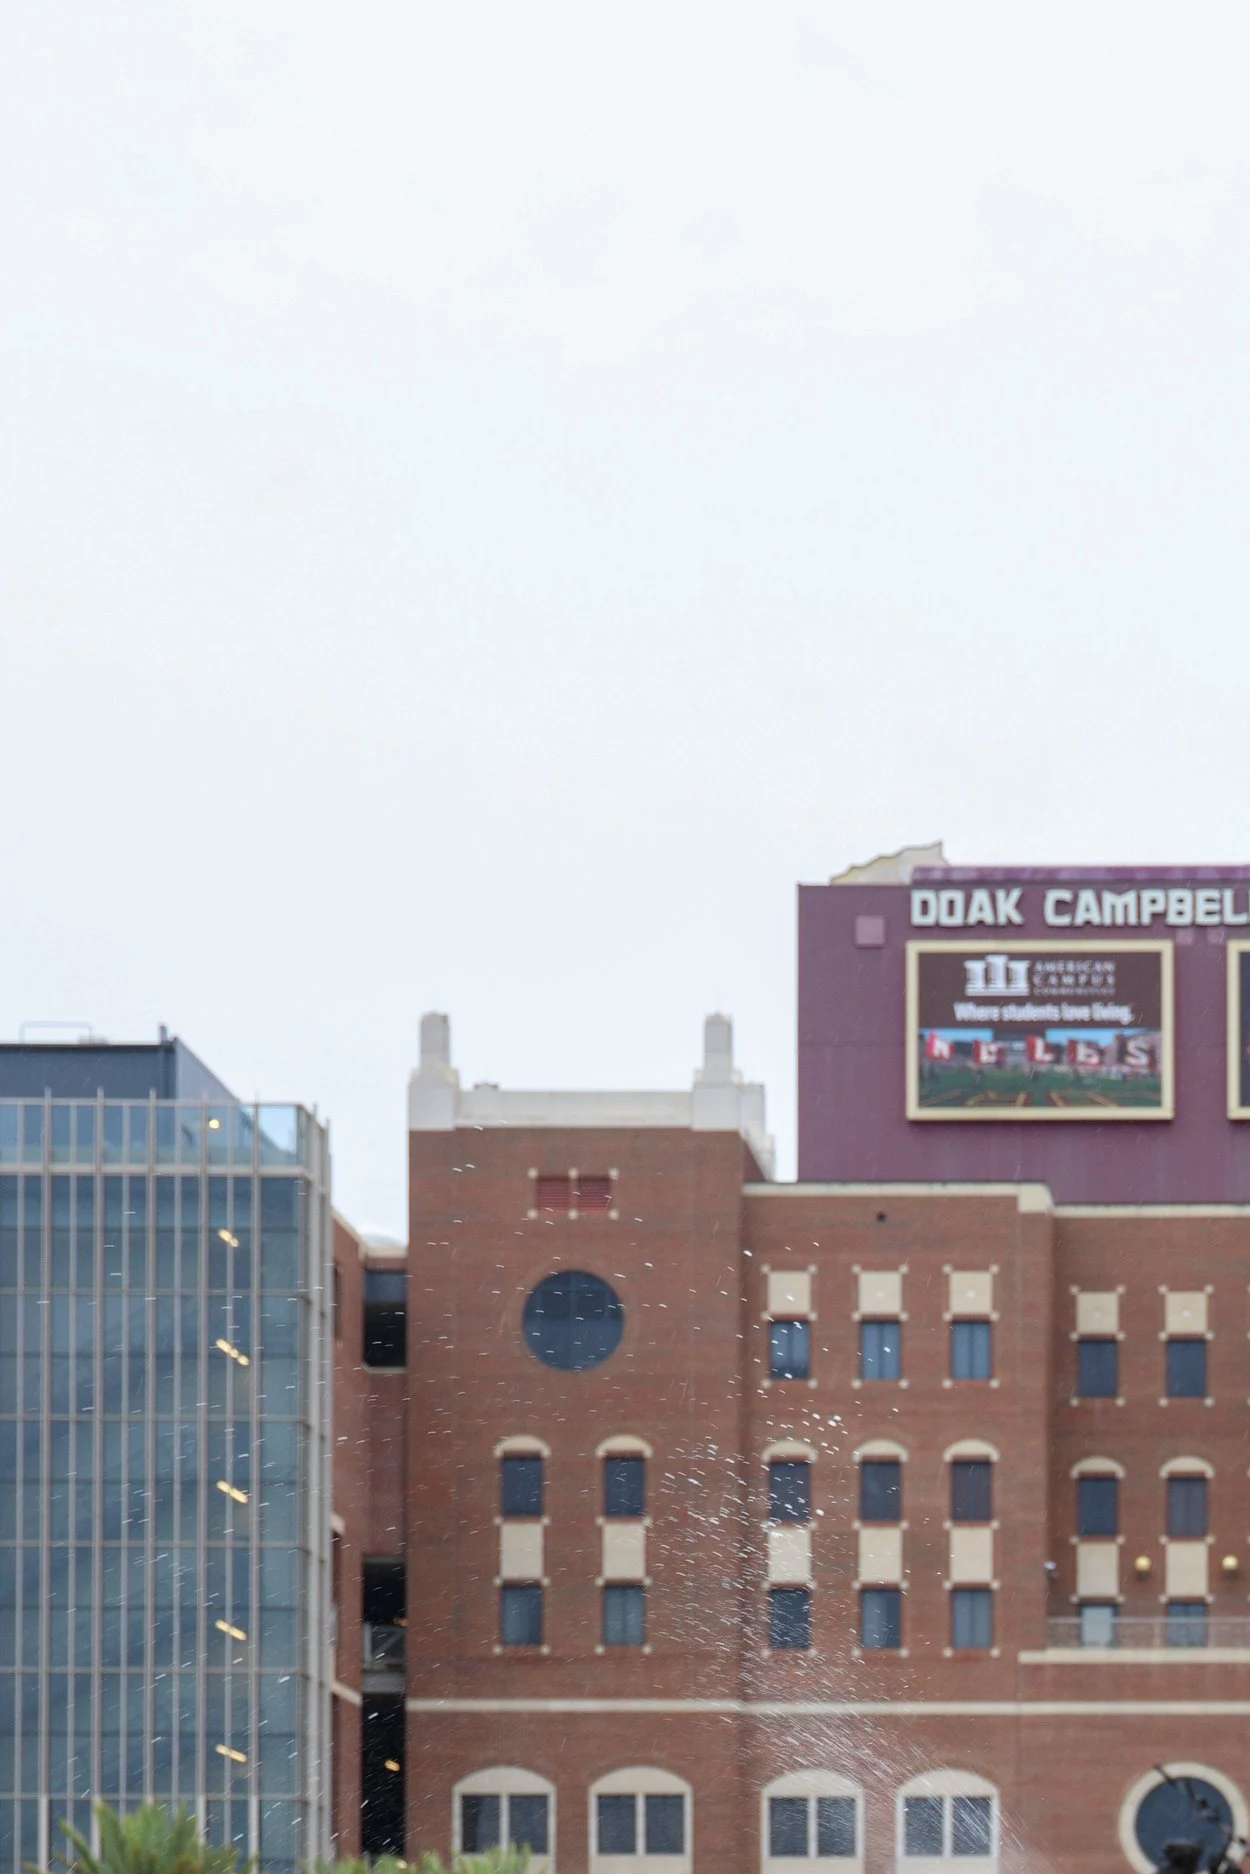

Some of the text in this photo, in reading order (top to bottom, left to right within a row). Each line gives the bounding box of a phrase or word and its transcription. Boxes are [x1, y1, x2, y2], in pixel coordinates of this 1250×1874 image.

[910, 887, 1024, 926] DOAK
[1033, 960, 1116, 973] AMERICAN
[1032, 974, 1116, 987] CAMPUS
[953, 1002, 1000, 1021] Where
[1001, 1002, 1061, 1021] students
[1061, 1002, 1091, 1021] love
